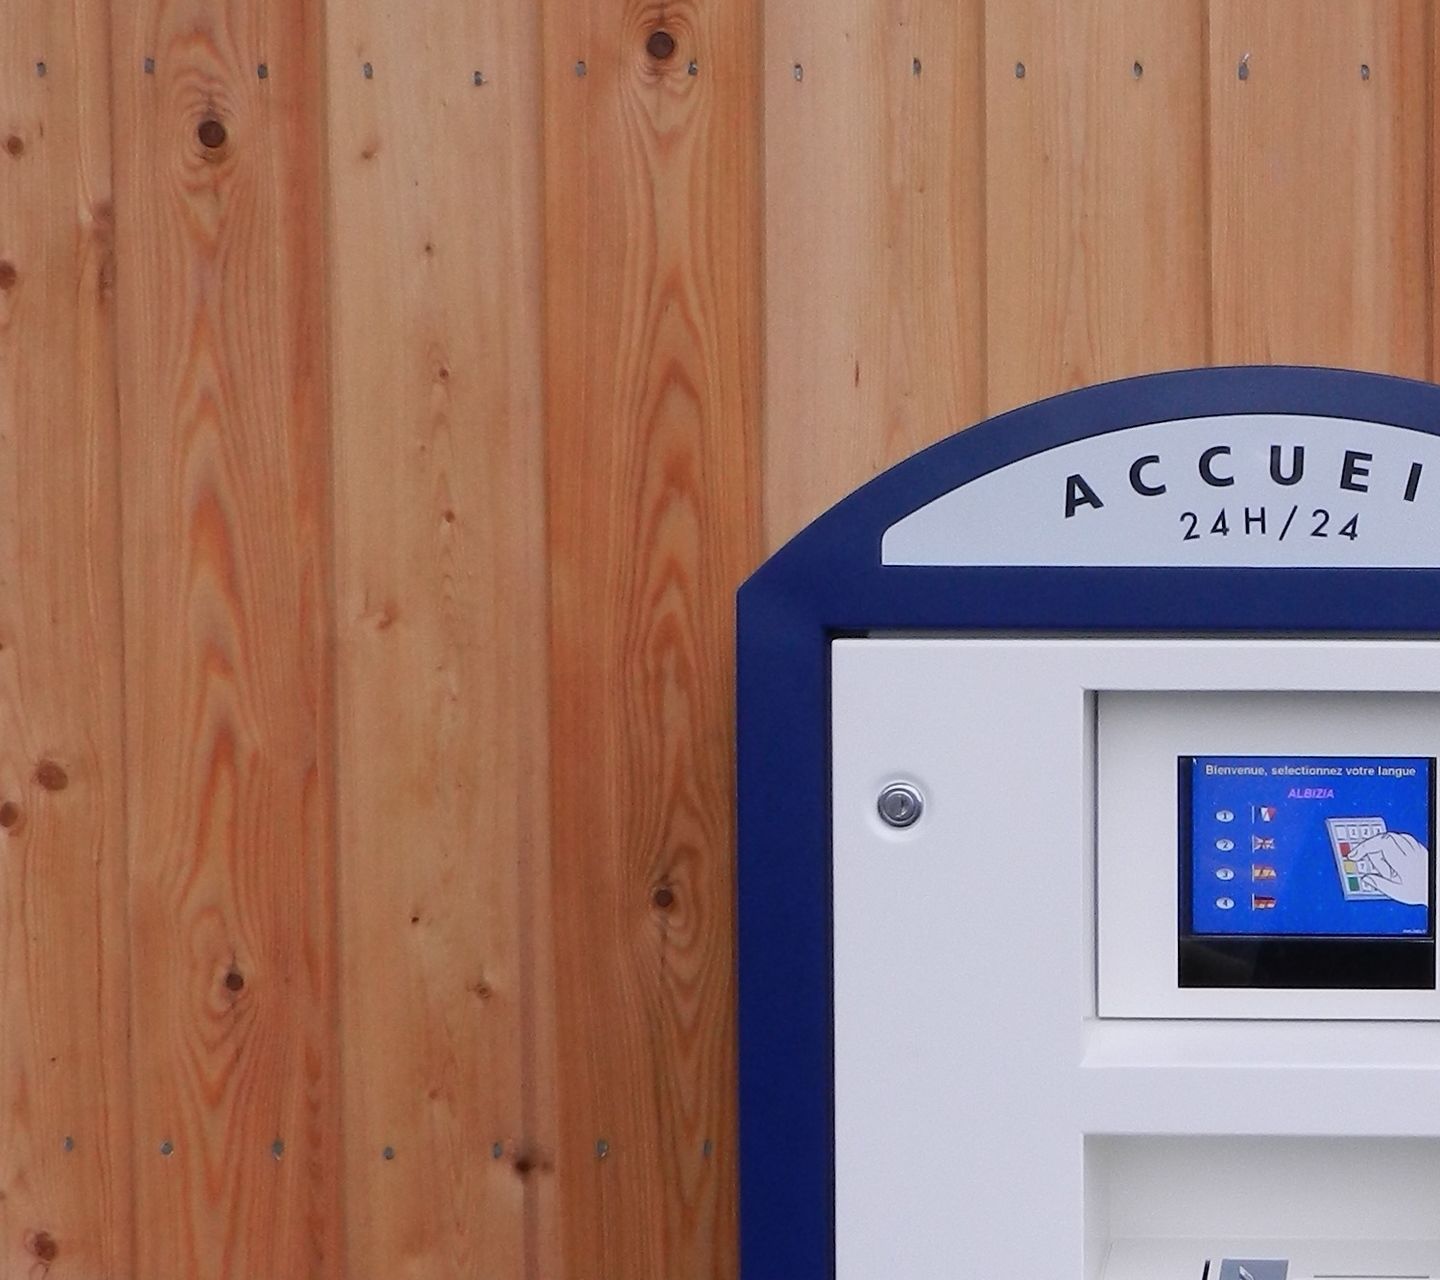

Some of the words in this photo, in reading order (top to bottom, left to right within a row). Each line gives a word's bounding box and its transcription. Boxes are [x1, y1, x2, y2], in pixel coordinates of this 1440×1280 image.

[1180, 505, 1359, 541] 24H/24
[1345, 766, 1375, 776] votre
[1378, 765, 1416, 778] langue
[1287, 788, 1335, 799] ALBIZIA
